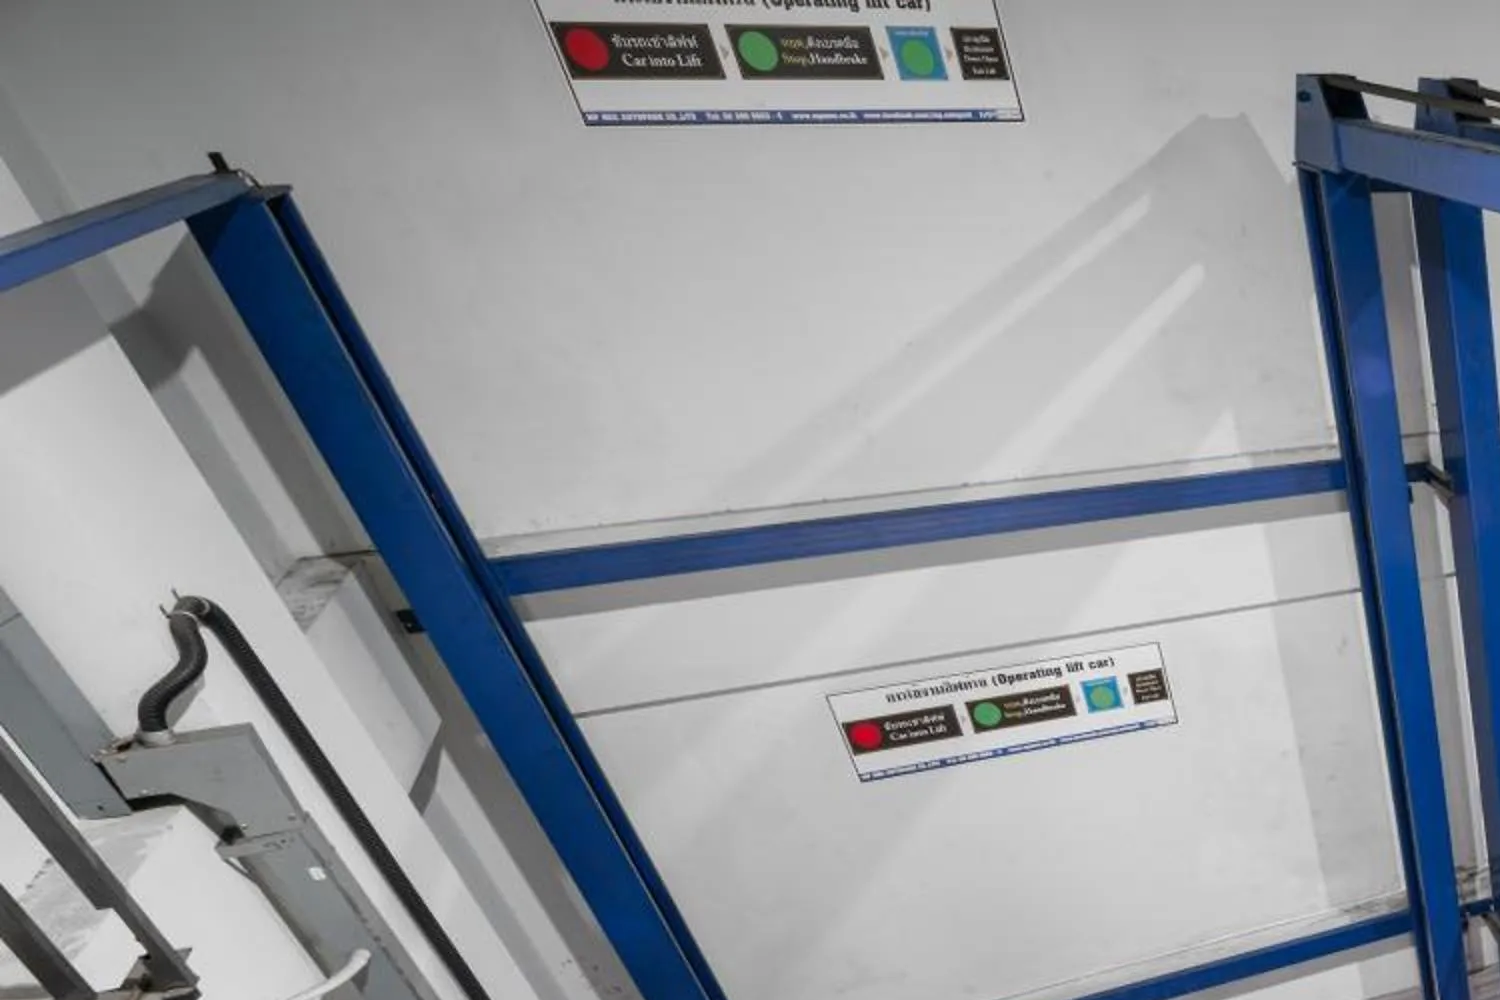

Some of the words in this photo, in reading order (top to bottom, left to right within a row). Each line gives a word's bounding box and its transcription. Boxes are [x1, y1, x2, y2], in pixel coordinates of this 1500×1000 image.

[621, 53, 646, 67] Car
[648, 53, 676, 67] into
[677, 53, 702, 67] Lift
[991, 664, 1063, 688] (Operating
[1065, 661, 1084, 674] lift
[1088, 657, 1116, 671] car)
